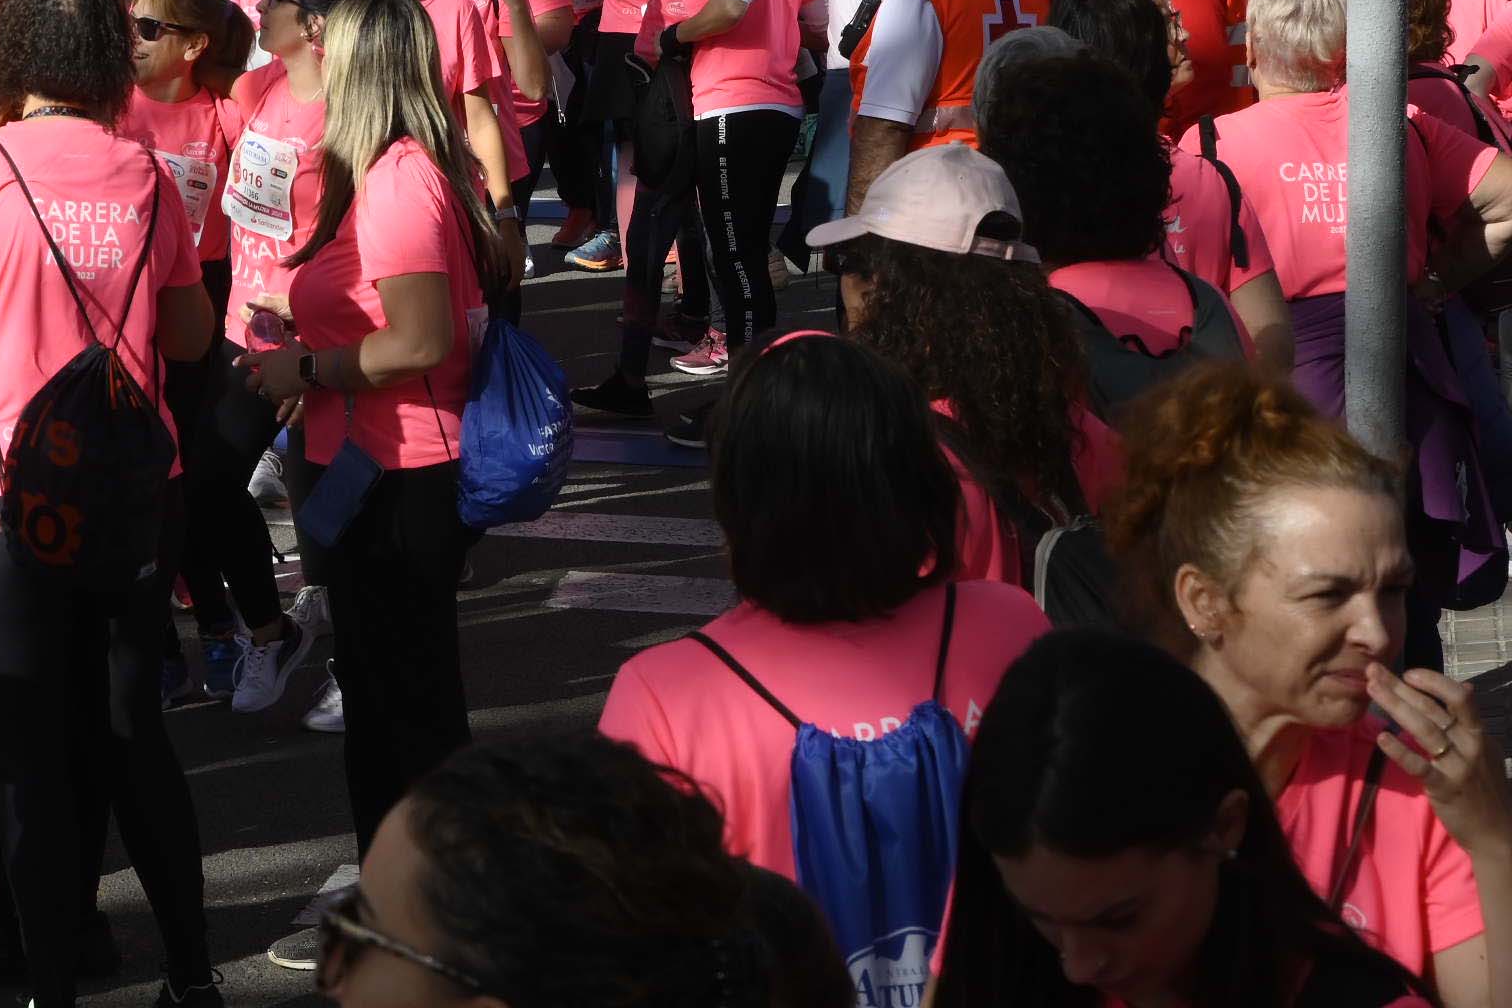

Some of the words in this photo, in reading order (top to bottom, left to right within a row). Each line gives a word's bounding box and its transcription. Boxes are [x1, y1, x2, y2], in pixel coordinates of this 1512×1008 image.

[719, 156, 727, 167] BE
[242, 167, 263, 190] 016
[719, 167, 730, 200] POSITIVE
[1303, 183, 1330, 202] DE
[1338, 182, 1347, 202] L
[31, 197, 140, 225] CARRERA
[723, 211, 733, 222] BE
[51, 223, 81, 245] DE
[90, 223, 120, 246] LA
[725, 222, 737, 252] POSITIVE
[734, 261, 742, 271] BE
[737, 270, 752, 300] POSITIVE
